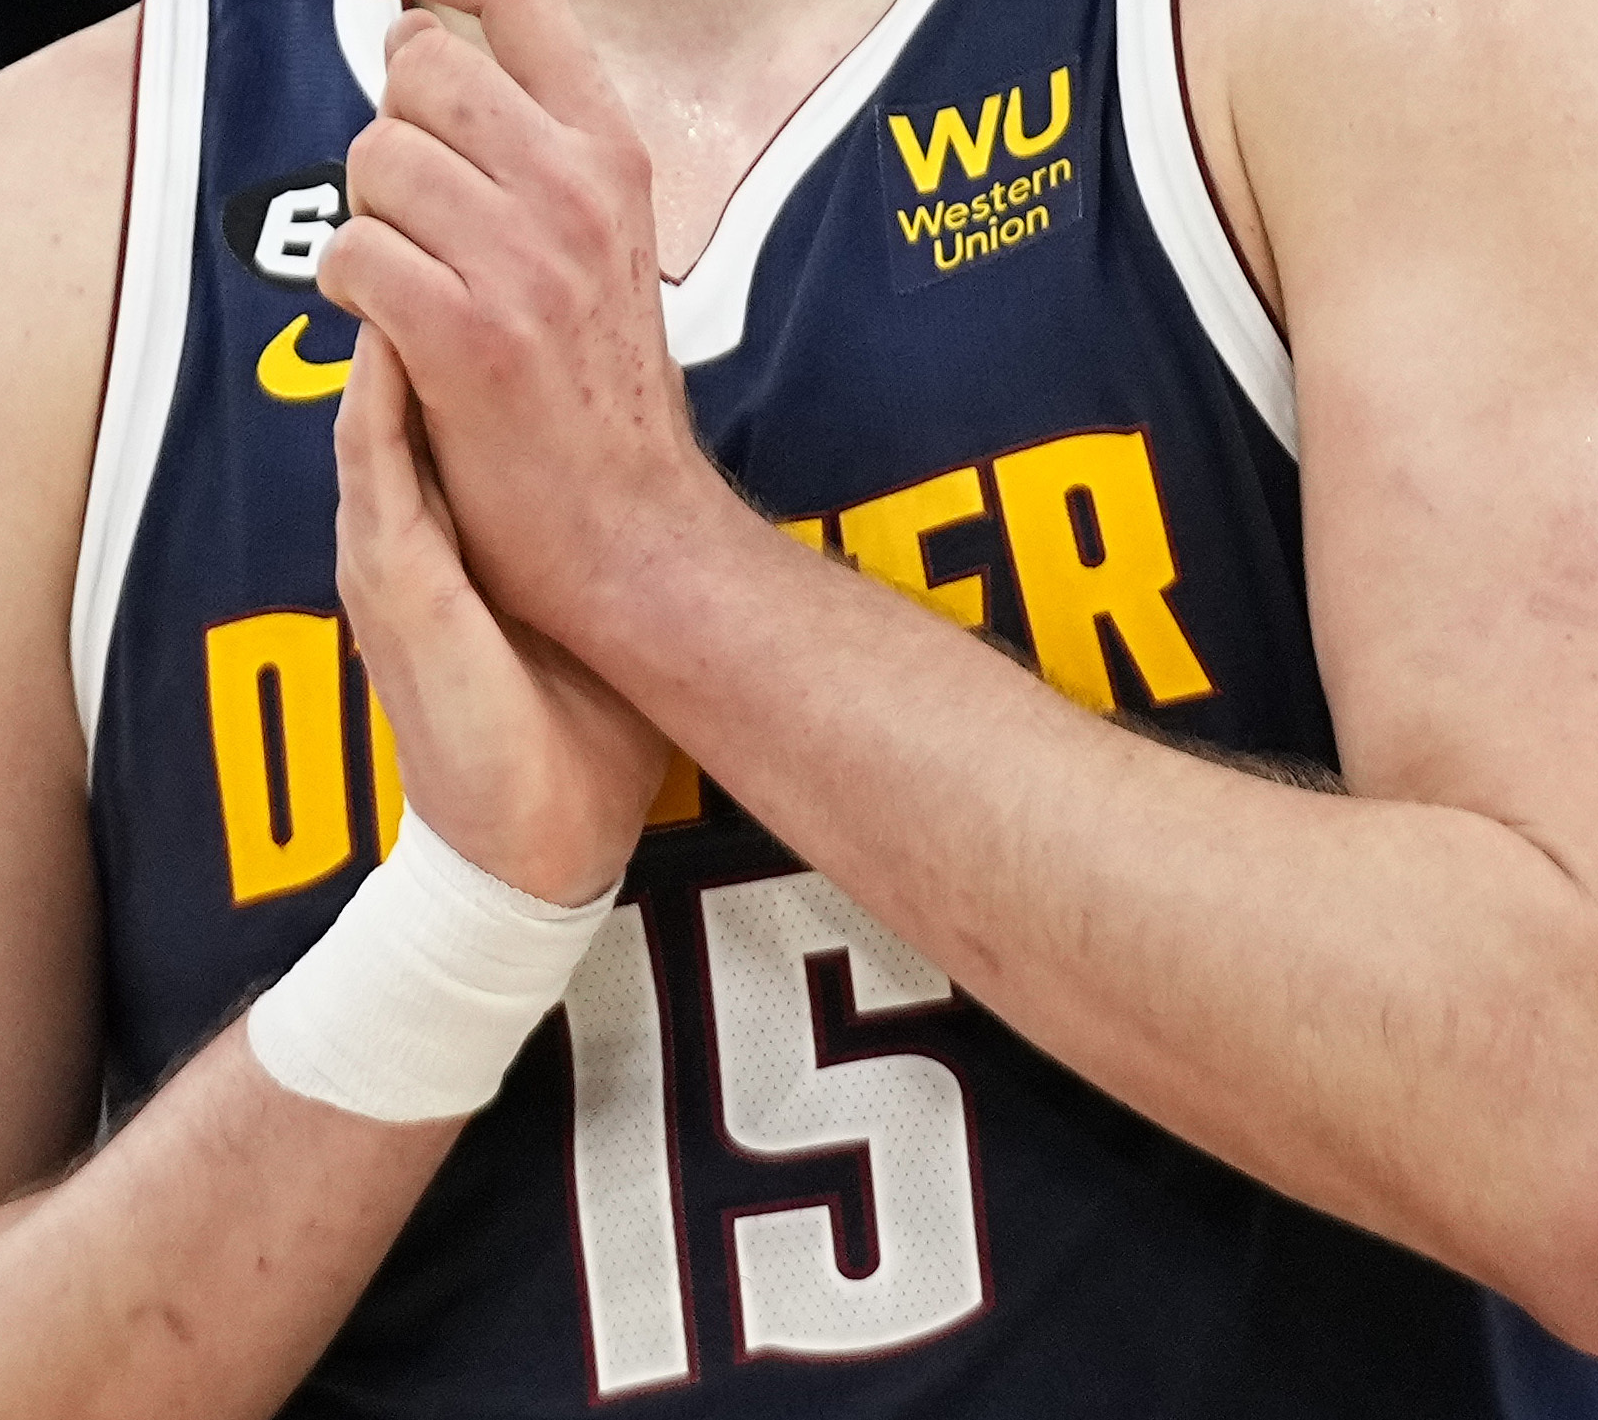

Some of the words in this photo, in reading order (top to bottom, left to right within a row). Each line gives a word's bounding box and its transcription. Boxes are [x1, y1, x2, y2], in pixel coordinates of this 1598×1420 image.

[888, 65, 1072, 195] WU
[253, 181, 341, 281] 6
[896, 156, 1074, 245] Western
[932, 204, 1052, 271] Union
[203, 426, 1218, 908] DER
[563, 871, 988, 1401] 15
